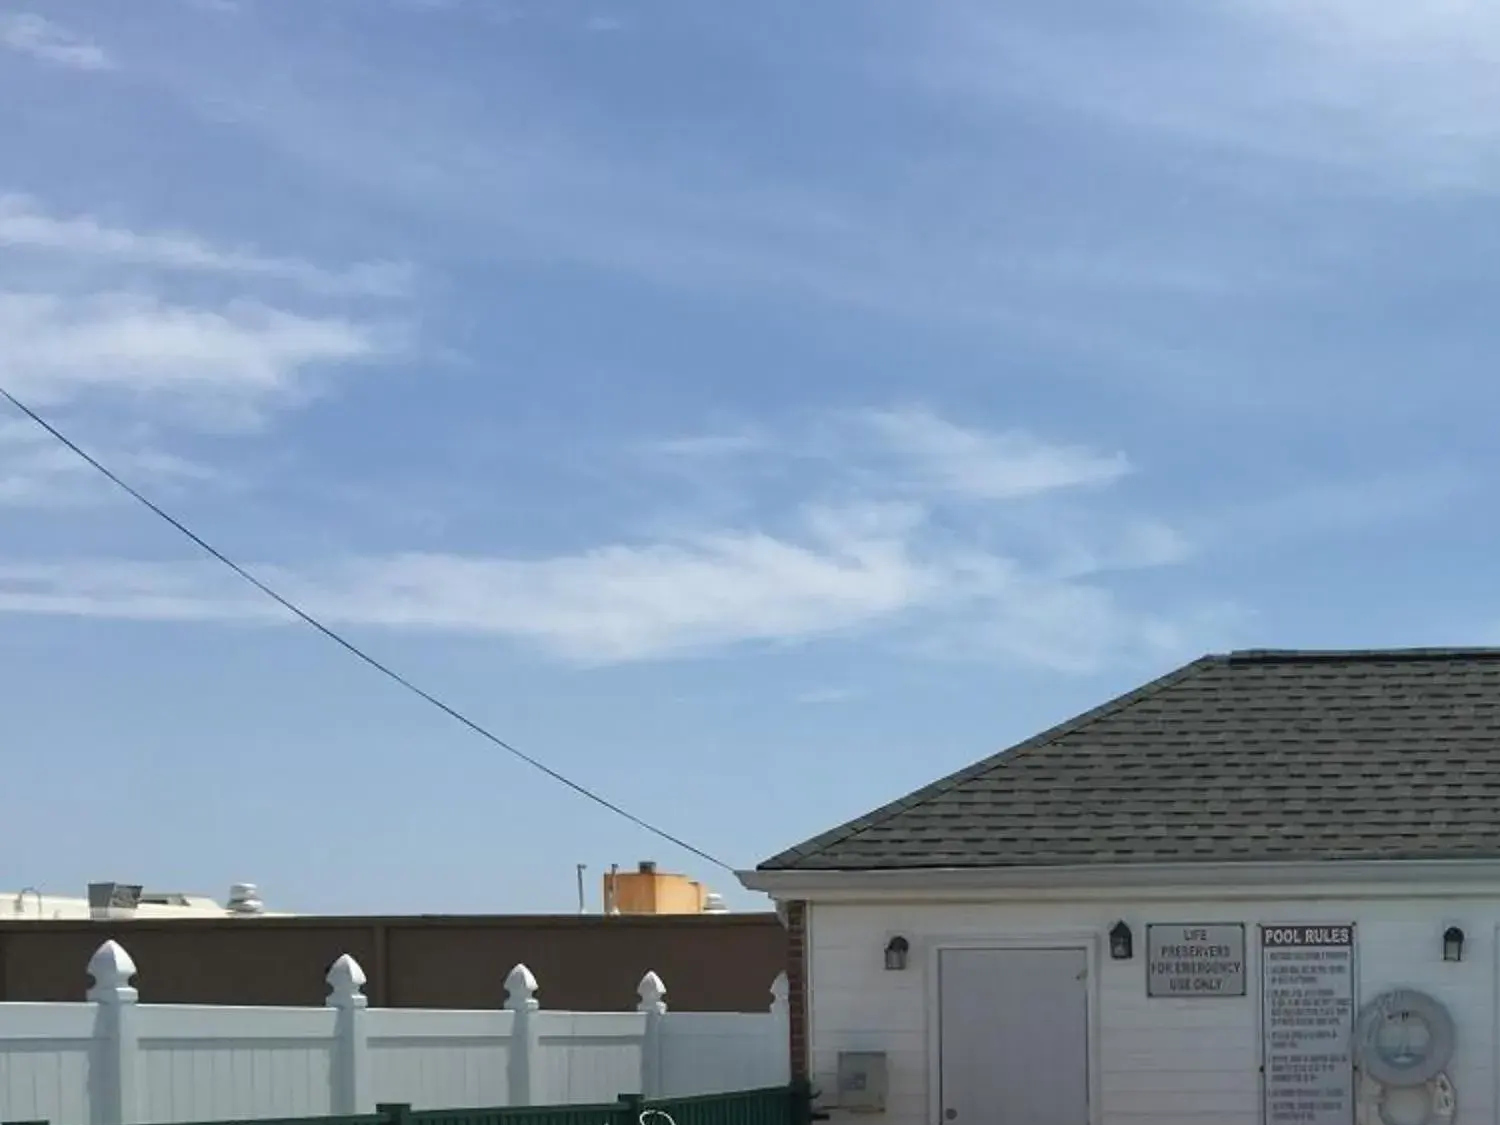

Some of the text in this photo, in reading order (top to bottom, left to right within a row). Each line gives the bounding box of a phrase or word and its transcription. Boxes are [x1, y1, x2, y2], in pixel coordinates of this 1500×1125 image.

[1183, 928, 1207, 941] LIFE
[1265, 928, 1349, 944] POOL RULES
[1169, 978, 1223, 991] USE ONLY
